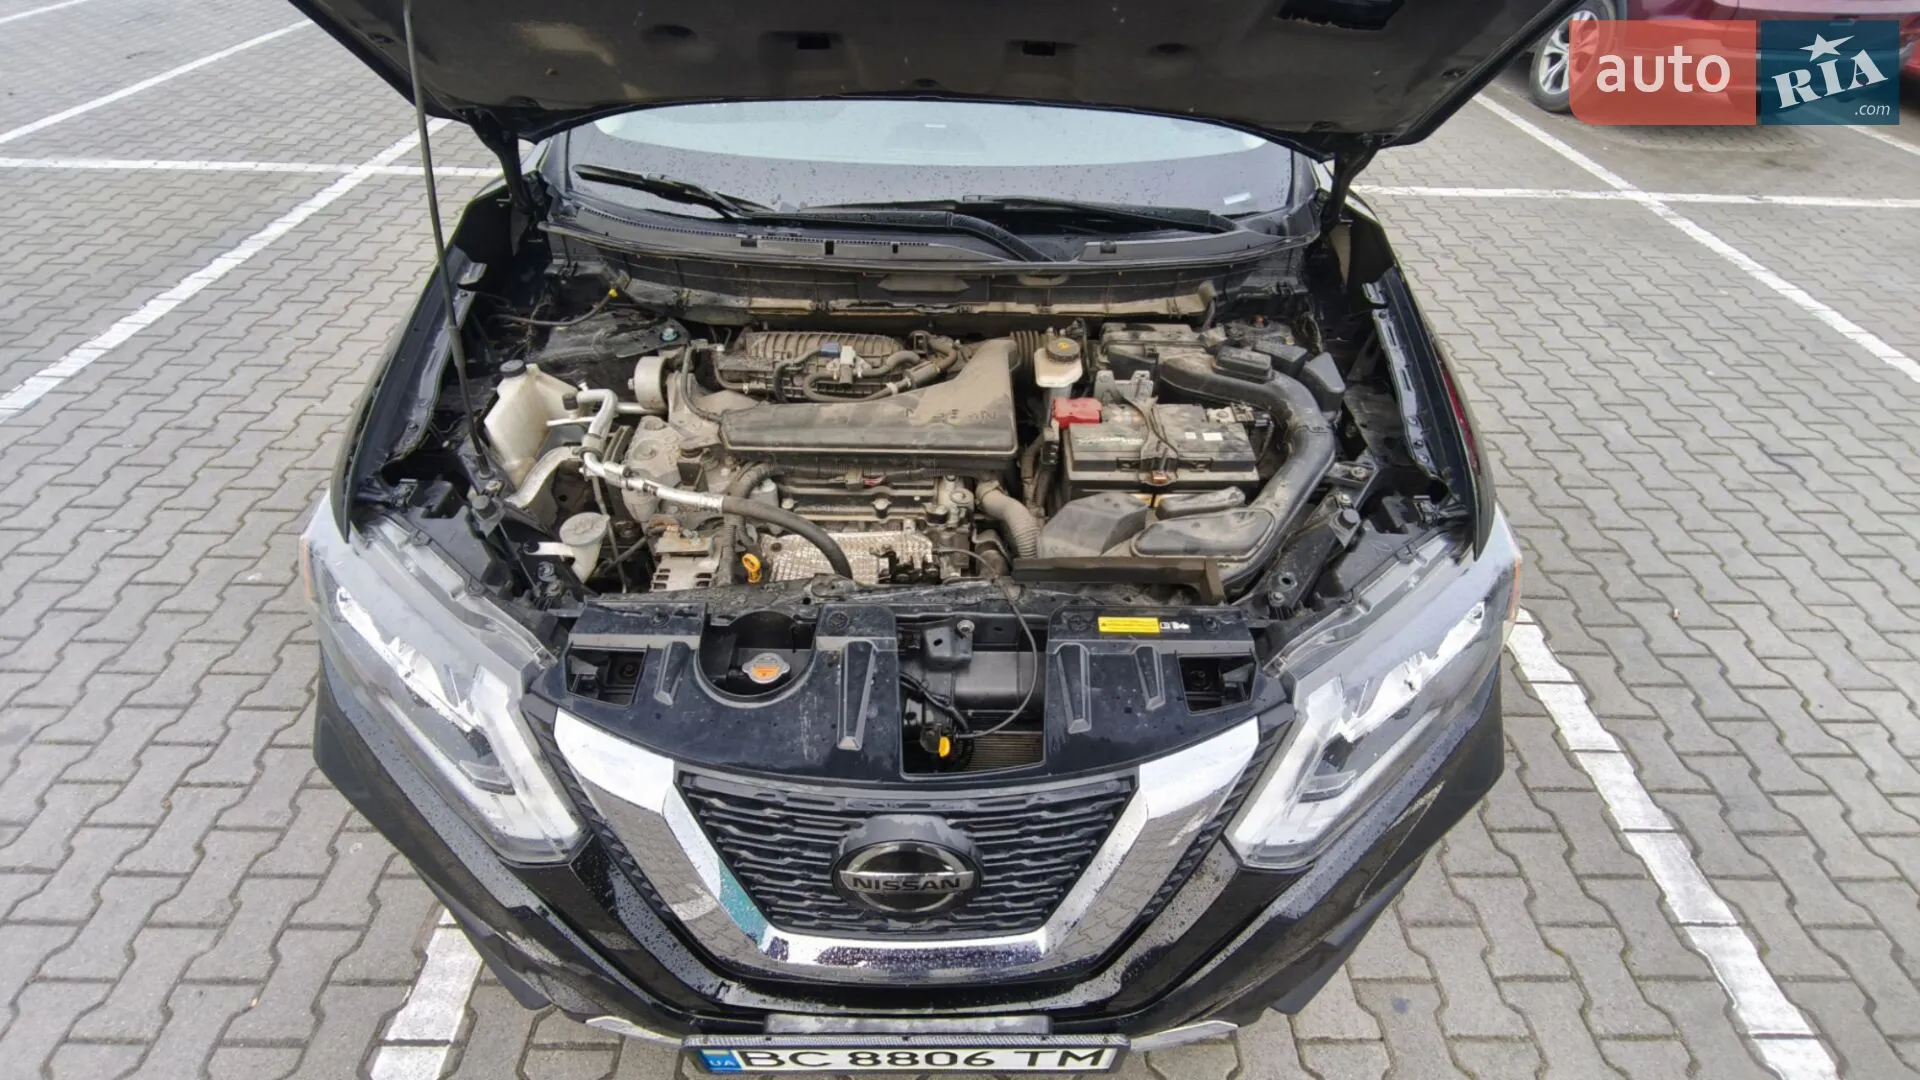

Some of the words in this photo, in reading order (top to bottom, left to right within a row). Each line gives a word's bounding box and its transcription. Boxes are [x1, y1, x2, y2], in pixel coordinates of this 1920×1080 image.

[853, 877, 960, 891] NISSAN
[711, 1059, 737, 1068] UA
[742, 1050, 831, 1067] BC
[848, 1052, 994, 1067] 8806
[1014, 1050, 1102, 1067] TM
